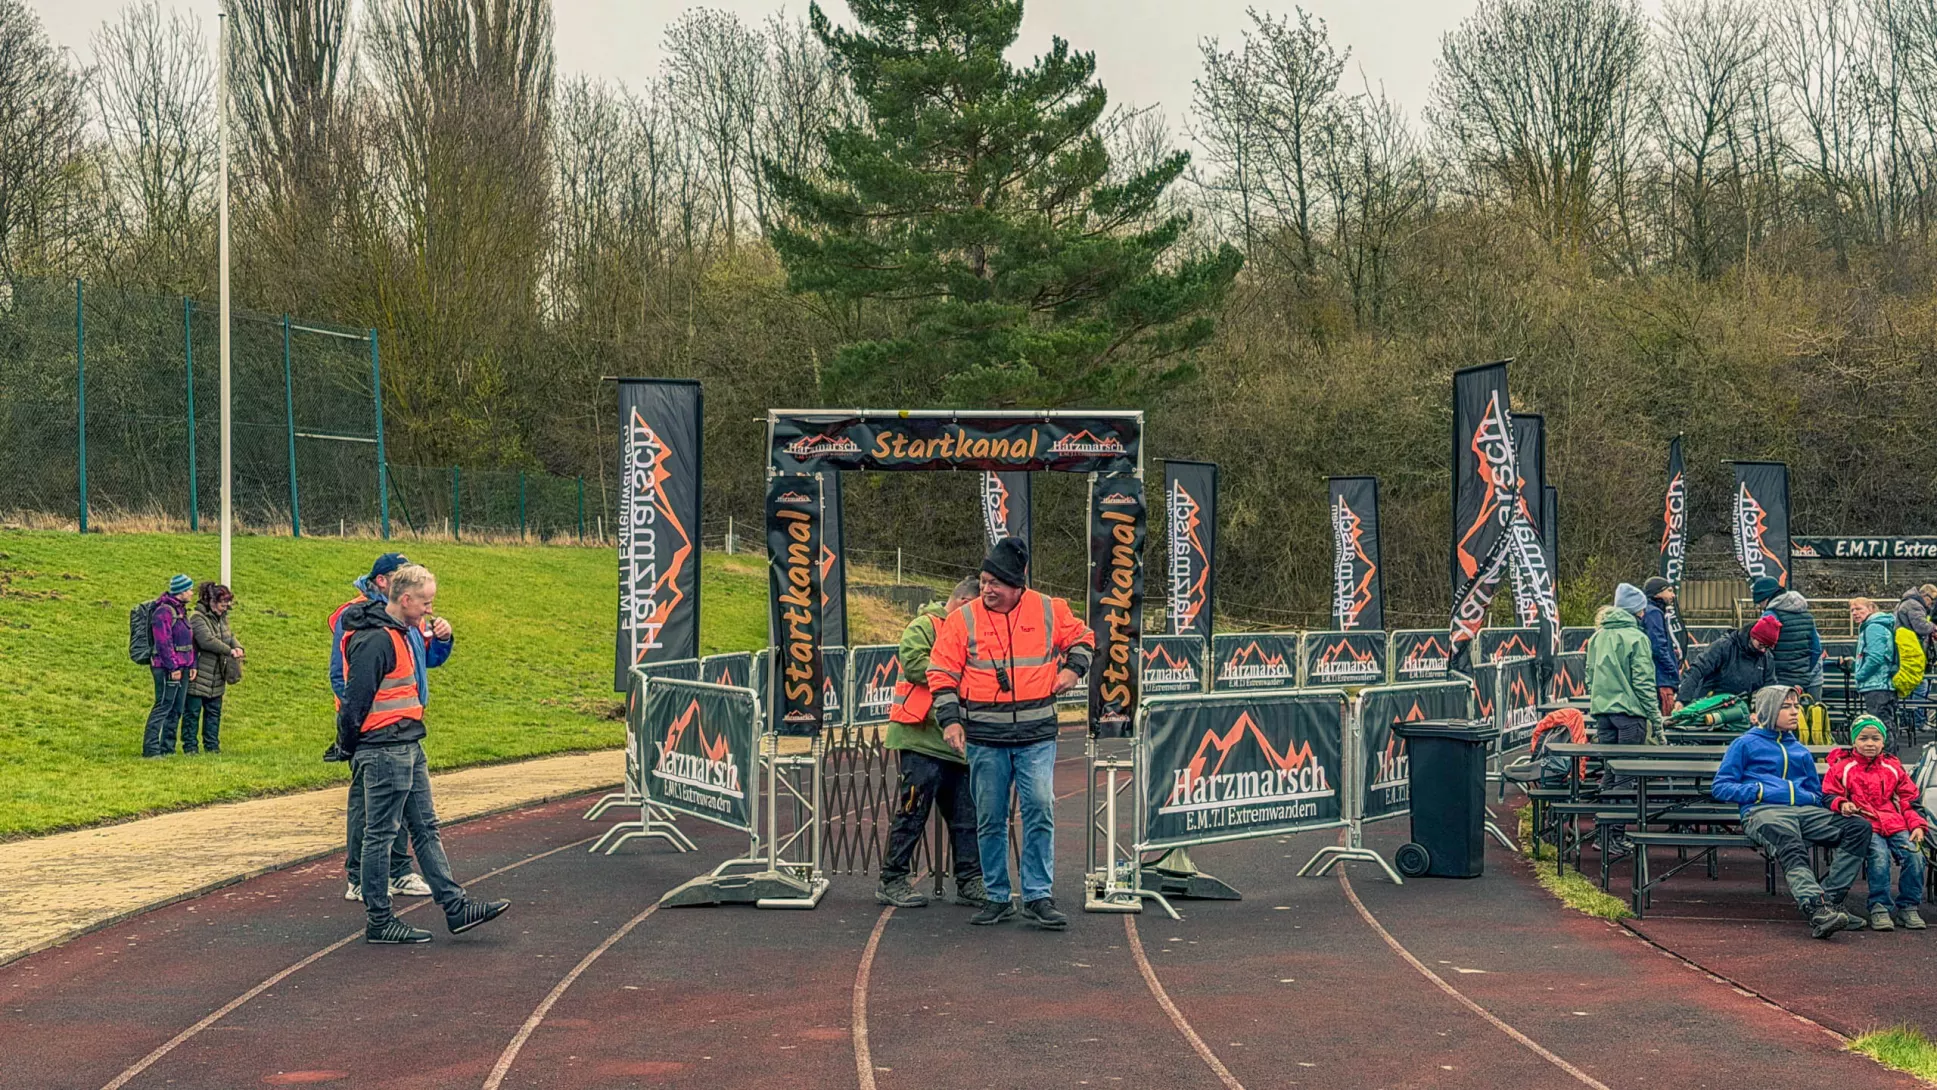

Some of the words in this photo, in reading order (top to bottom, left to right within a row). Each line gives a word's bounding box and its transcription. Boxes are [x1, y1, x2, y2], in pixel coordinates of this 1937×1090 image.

[871, 428, 1038, 459] Startkanal
[1836, 541, 1888, 557] E.M.T.I
[1894, 541, 1937, 557] Extre
[776, 510, 813, 705] Startkanal
[1101, 511, 1136, 707] Startkanal
[1144, 663, 1196, 680] rzmarsch
[1223, 660, 1290, 677] Harzmarsch
[1316, 657, 1378, 673] Harzmarsch
[1404, 655, 1449, 670] Harzmar
[1171, 757, 1327, 805] Harzmarsch
[1186, 808, 1225, 831] E.M.T.I
[1228, 800, 1318, 825] Extremwandern
